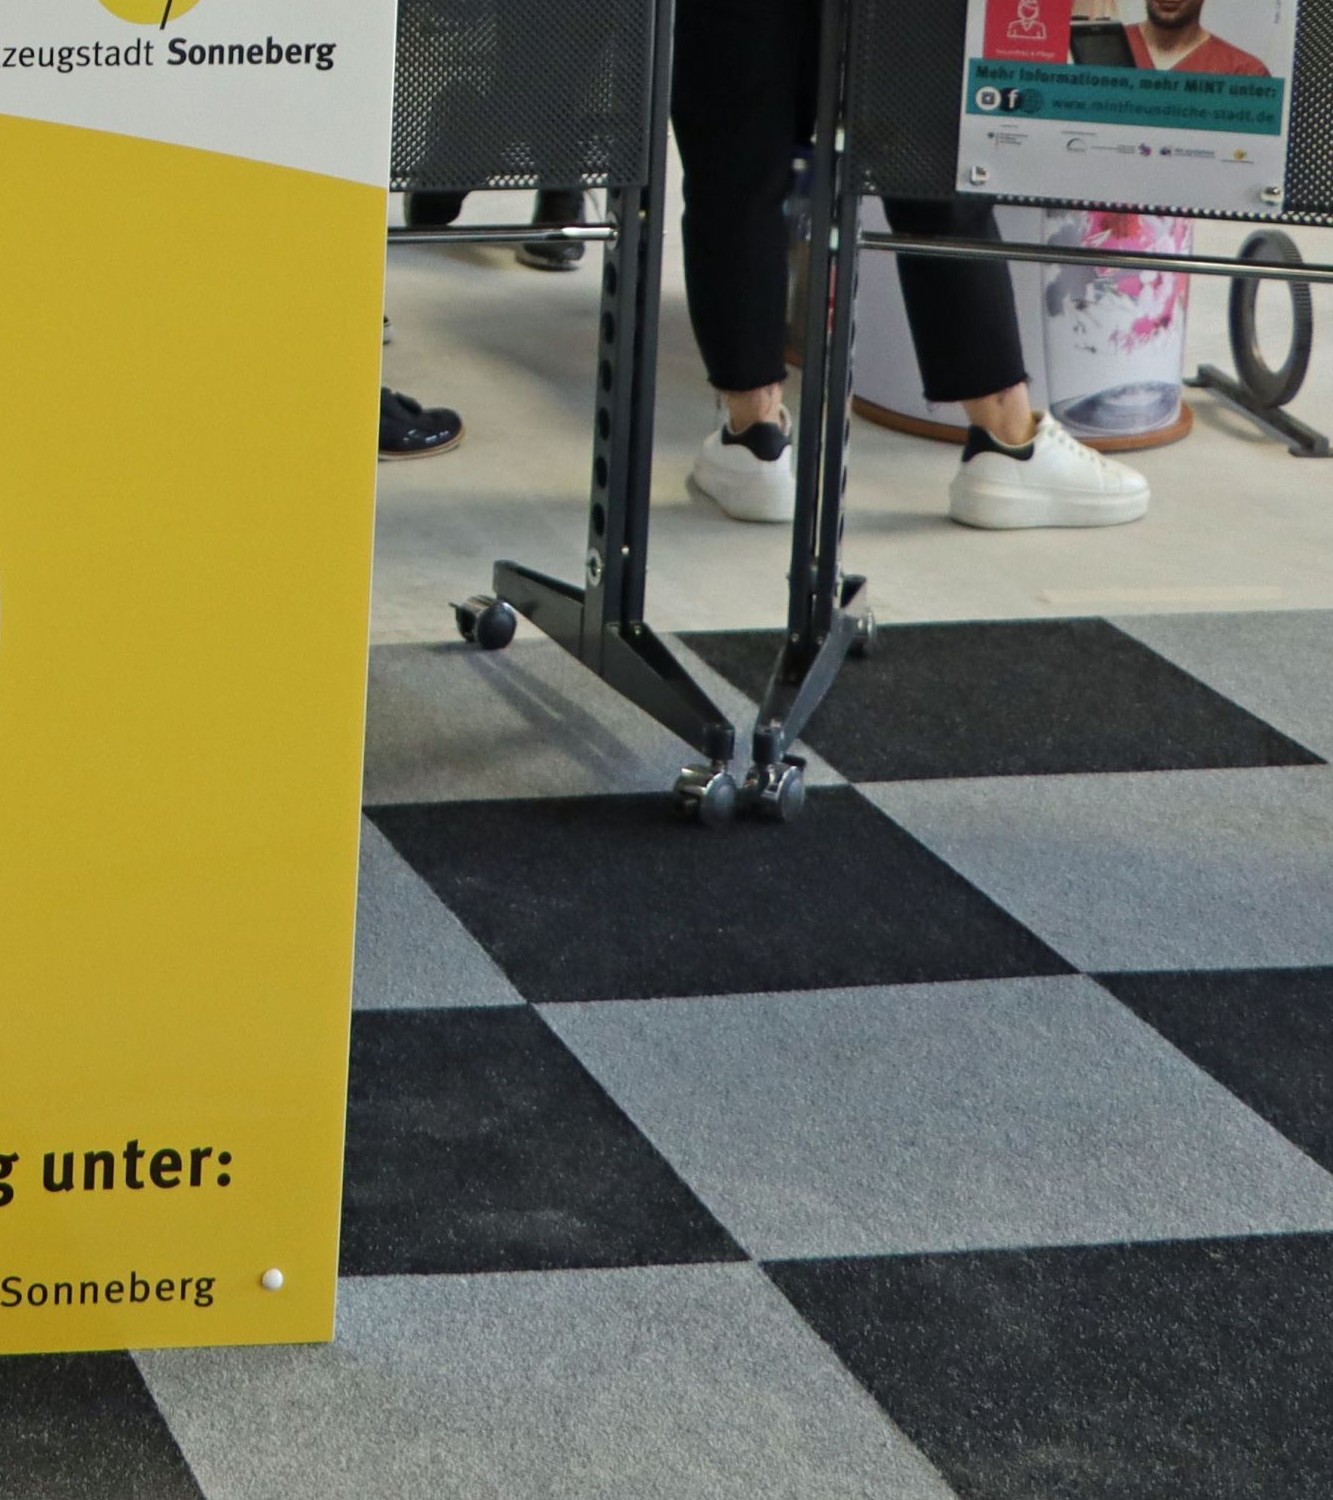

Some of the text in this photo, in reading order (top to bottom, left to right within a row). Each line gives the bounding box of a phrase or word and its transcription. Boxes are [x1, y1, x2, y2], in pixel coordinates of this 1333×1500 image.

[166, 36, 336, 71] Sonneberg
[976, 64, 1277, 99] Mehr Informationen, mehr MINT unter:
[42, 1139, 233, 1192] unter:
